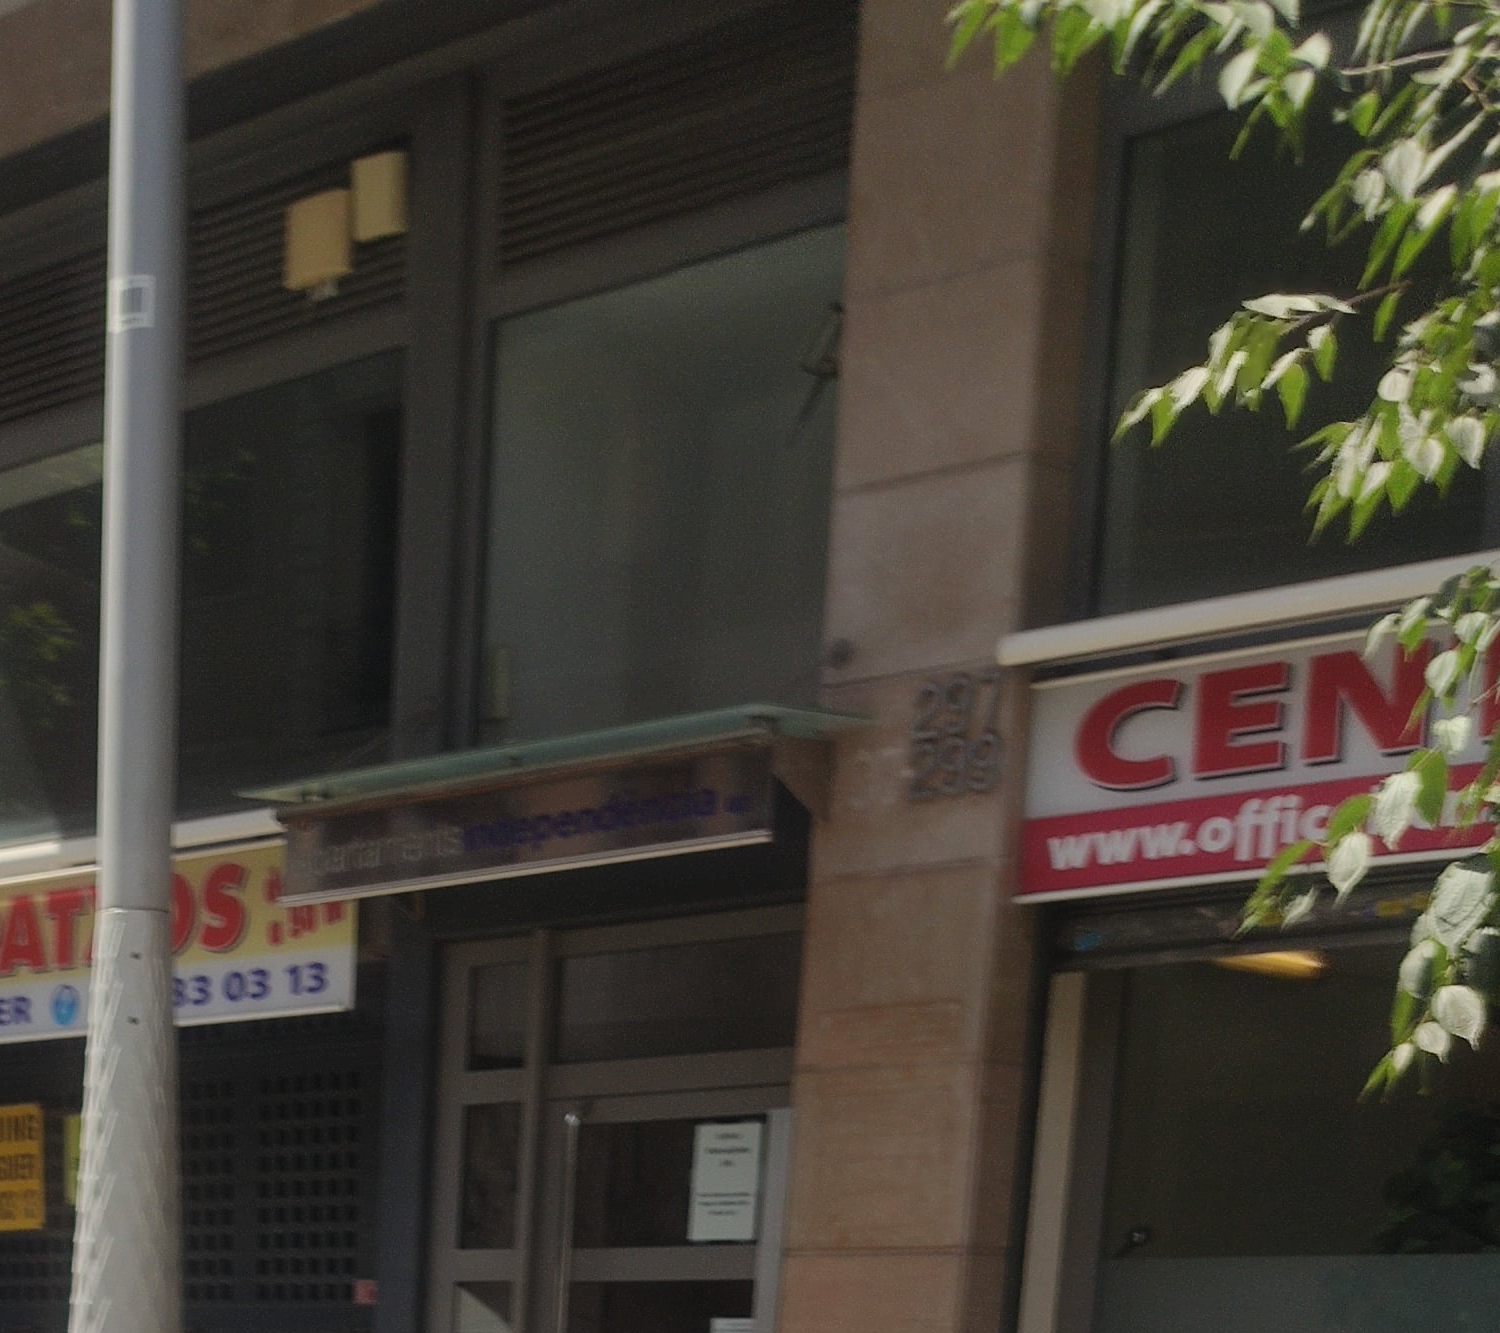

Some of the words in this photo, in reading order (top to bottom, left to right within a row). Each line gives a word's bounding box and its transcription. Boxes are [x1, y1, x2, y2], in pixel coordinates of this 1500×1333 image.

[913, 671, 1001, 740] 297
[1075, 632, 1500, 790] CEN
[909, 734, 1001, 801] 299
[224, 968, 270, 1001] 03
[284, 961, 328, 994] 13
